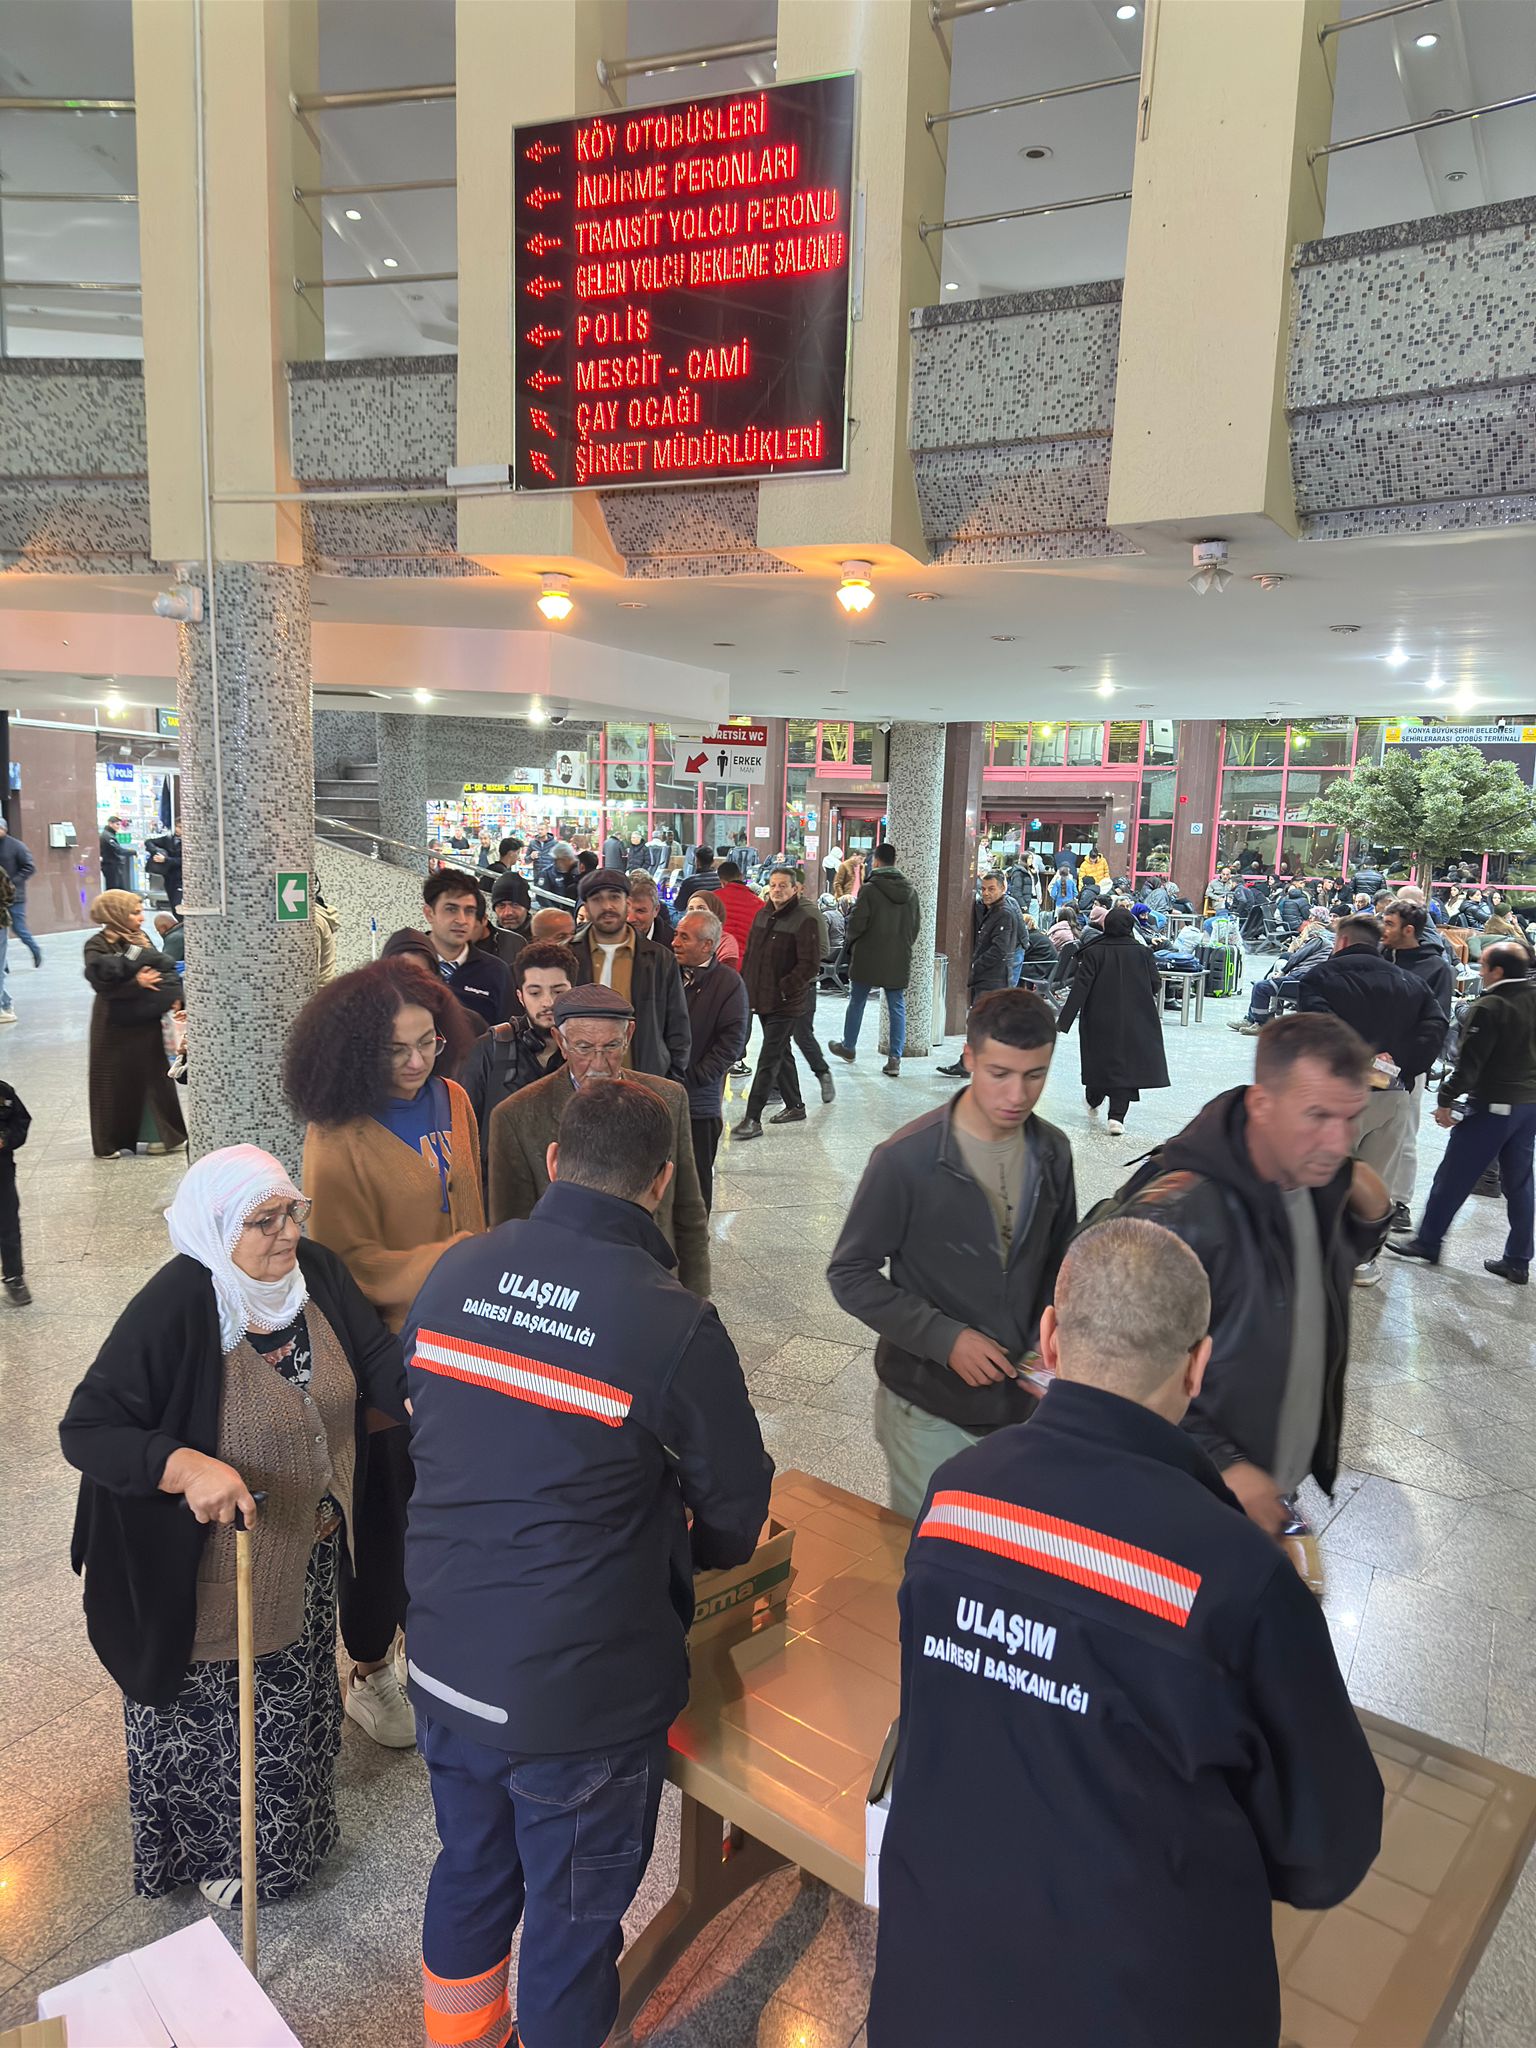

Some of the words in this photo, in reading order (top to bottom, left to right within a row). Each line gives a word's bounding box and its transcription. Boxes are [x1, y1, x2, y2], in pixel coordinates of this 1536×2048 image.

[576, 120, 617, 161] KÖY
[626, 92, 767, 152] OTOBÜSLERİ
[576, 163, 667, 208] İNDİRME
[674, 145, 798, 195] PERONLARI
[575, 208, 663, 254] TRANSİT
[669, 202, 738, 242] YOLCU
[748, 189, 837, 231] PERONU
[576, 260, 626, 298] GELEN
[631, 252, 684, 291] YOLCU
[690, 243, 769, 284] BEKLEME
[774, 233, 842, 274] SALONU
[576, 305, 649, 346] POLİS
[576, 349, 662, 391] MESCİT
[688, 338, 749, 380] CAMİ
[576, 401, 620, 440] ÇAY
[628, 387, 699, 427] OCAĞI
[575, 440, 647, 484] ŞİRKET
[653, 421, 822, 470] MÜDÜRLÜKLERİ
[748, 731, 764, 741] WC
[1408, 727, 1431, 735] KONYA
[1431, 726, 1474, 735] BÜYÜKŞEHİR
[1455, 734, 1483, 742] OTOBÜS
[115, 768, 133, 778] POLİS
[733, 756, 762, 766] ERKEK
[498, 1271, 580, 1312] ULAŞIM
[462, 1298, 513, 1324] DAİRESİ
[512, 1310, 596, 1348] BAŞKANLIĞI
[695, 1580, 756, 1621] oma
[956, 1596, 1057, 1661] ULAŞIM
[923, 1634, 981, 1675] DAİRESİ
[983, 1656, 1089, 1714] BAŞKANLIĞI
